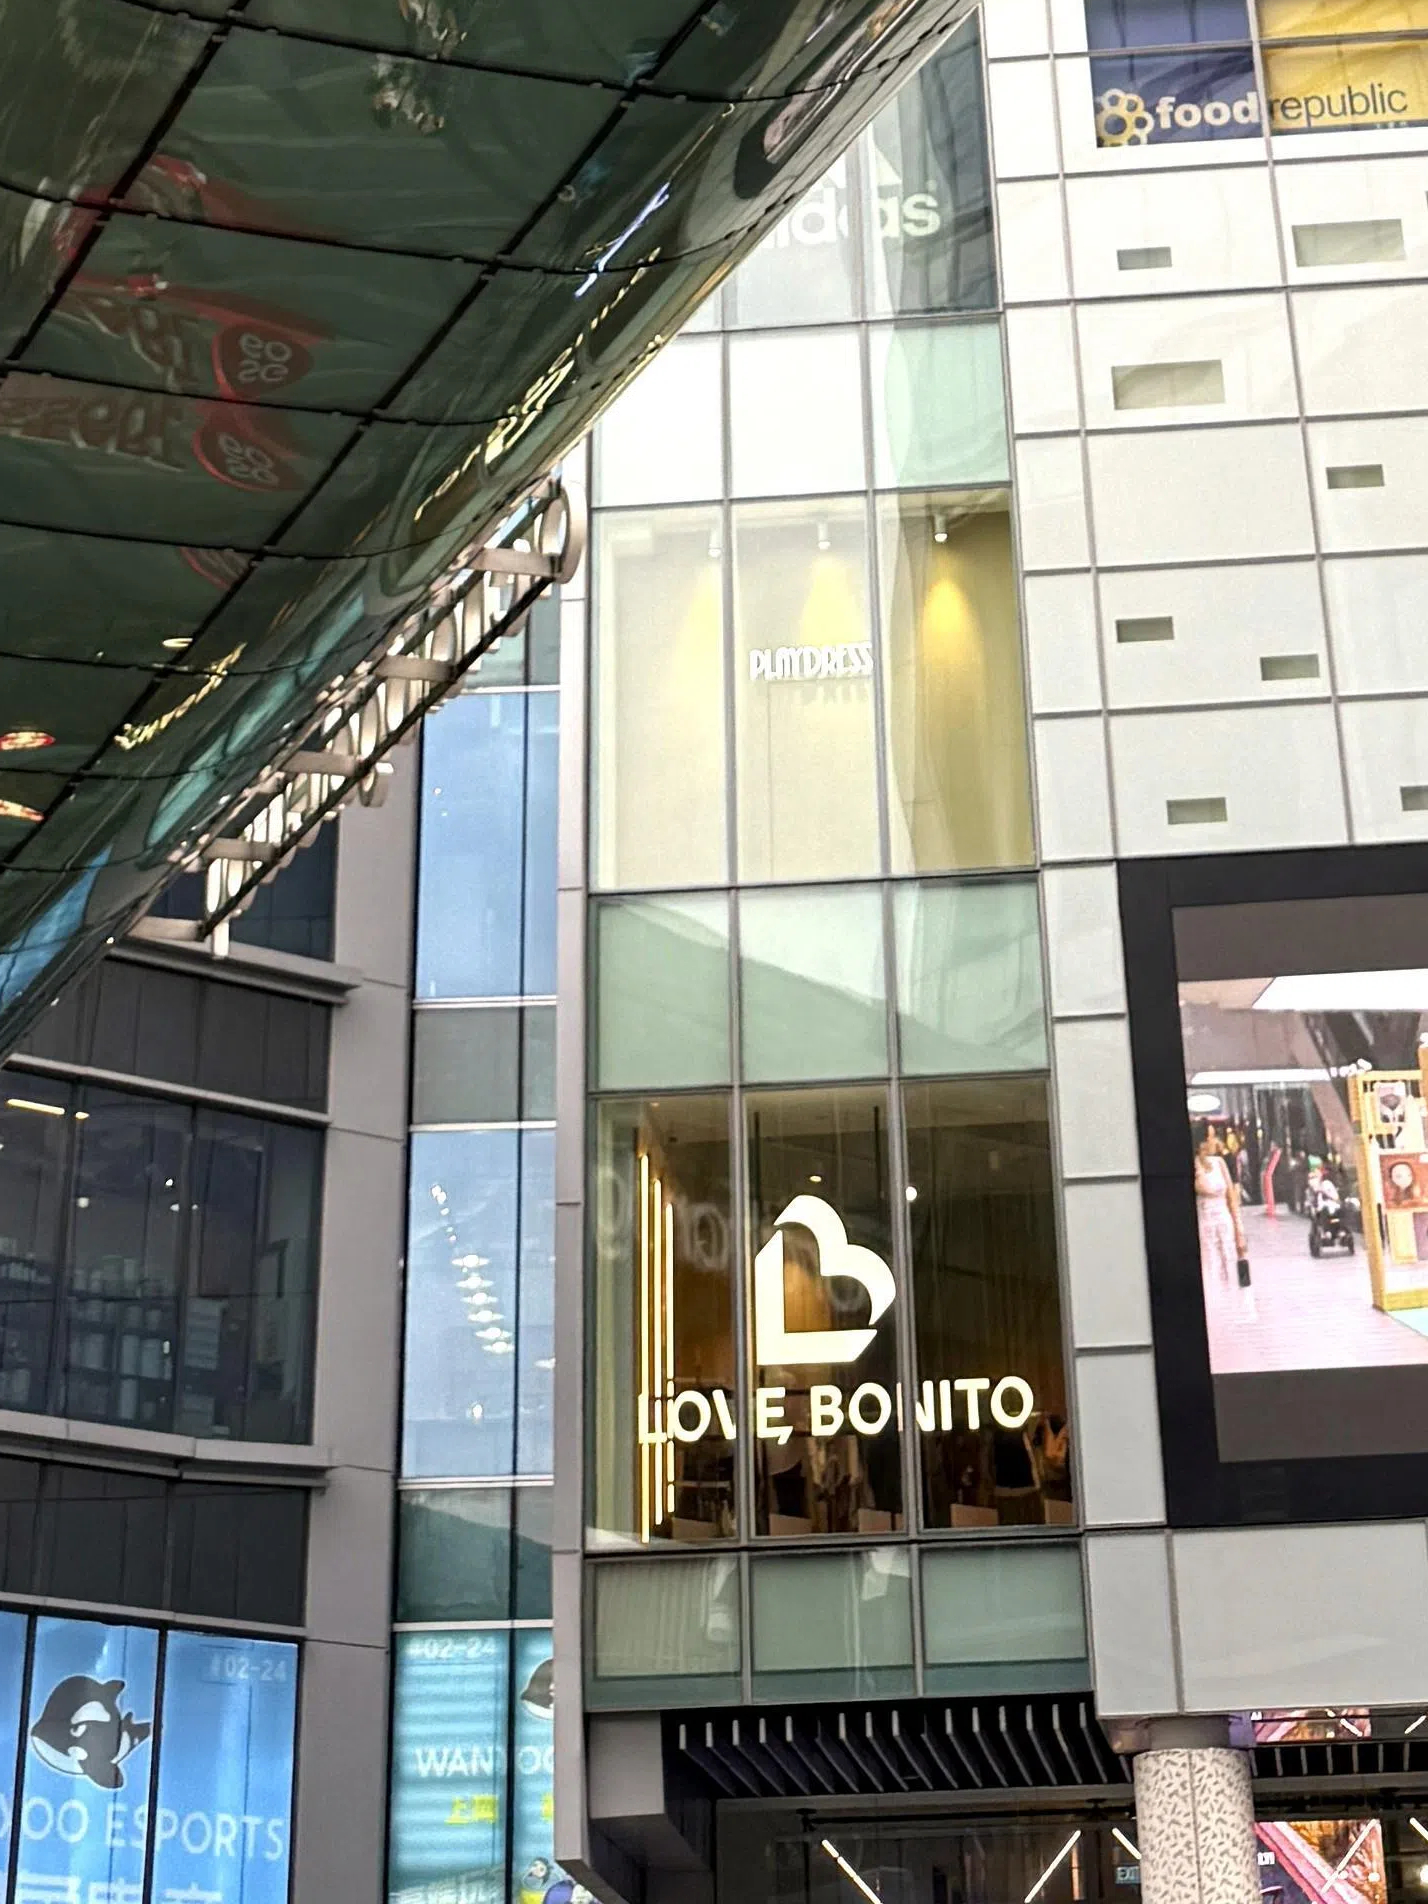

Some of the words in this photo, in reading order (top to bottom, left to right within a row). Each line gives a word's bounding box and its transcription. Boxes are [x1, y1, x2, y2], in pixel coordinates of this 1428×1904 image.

[1156, 91, 1262, 130] food
[1268, 81, 1409, 128] republic
[810, 1375, 1035, 1437] BONITO
[105, 1801, 285, 1862] ESPORTS
